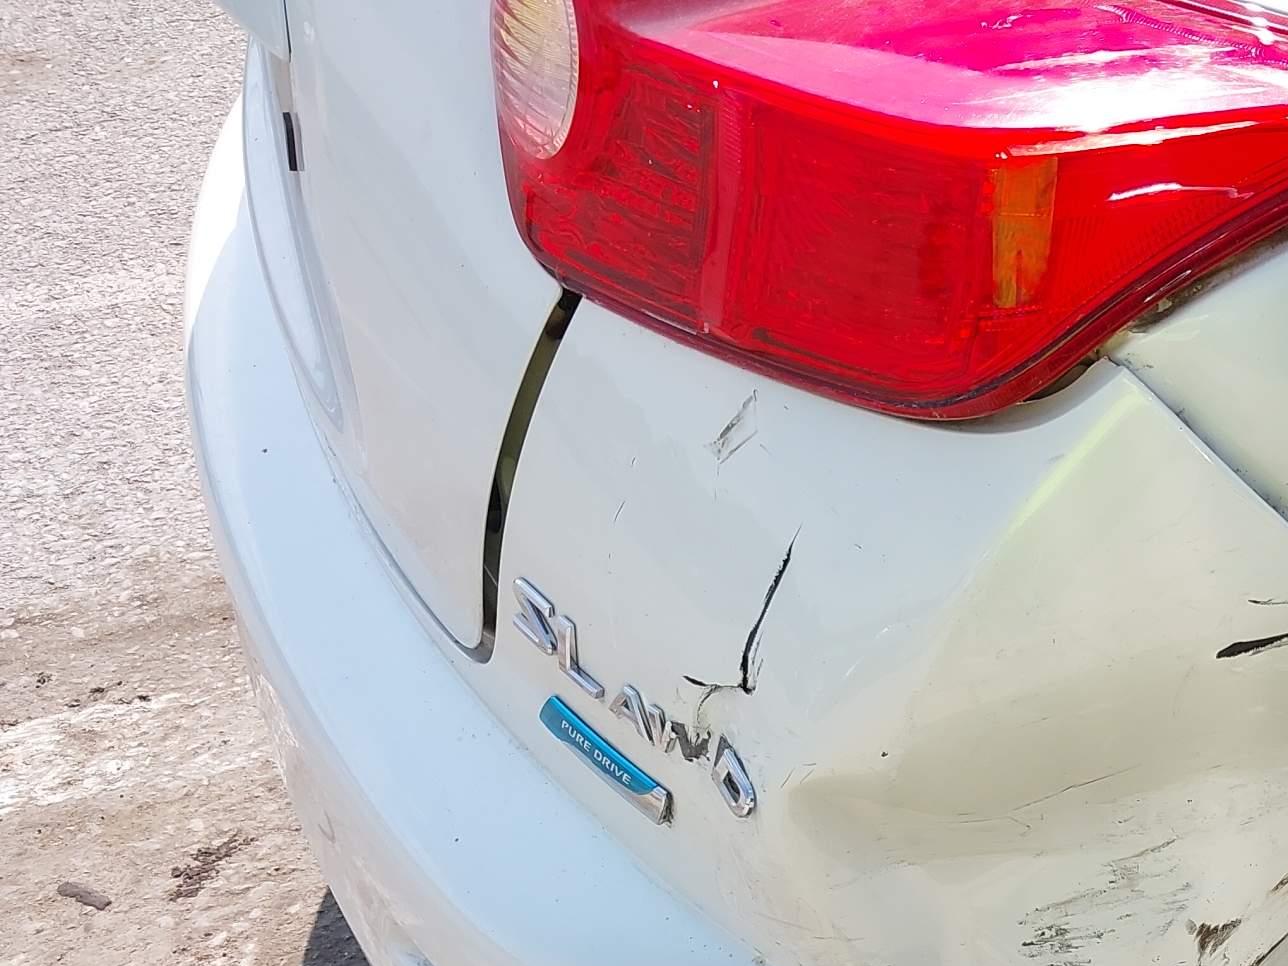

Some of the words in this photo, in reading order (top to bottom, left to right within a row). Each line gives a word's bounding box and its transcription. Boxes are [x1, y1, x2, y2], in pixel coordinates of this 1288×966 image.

[512, 577, 605, 700] SL
[560, 719, 592, 752] PURE
[593, 748, 632, 785] DRIVE
